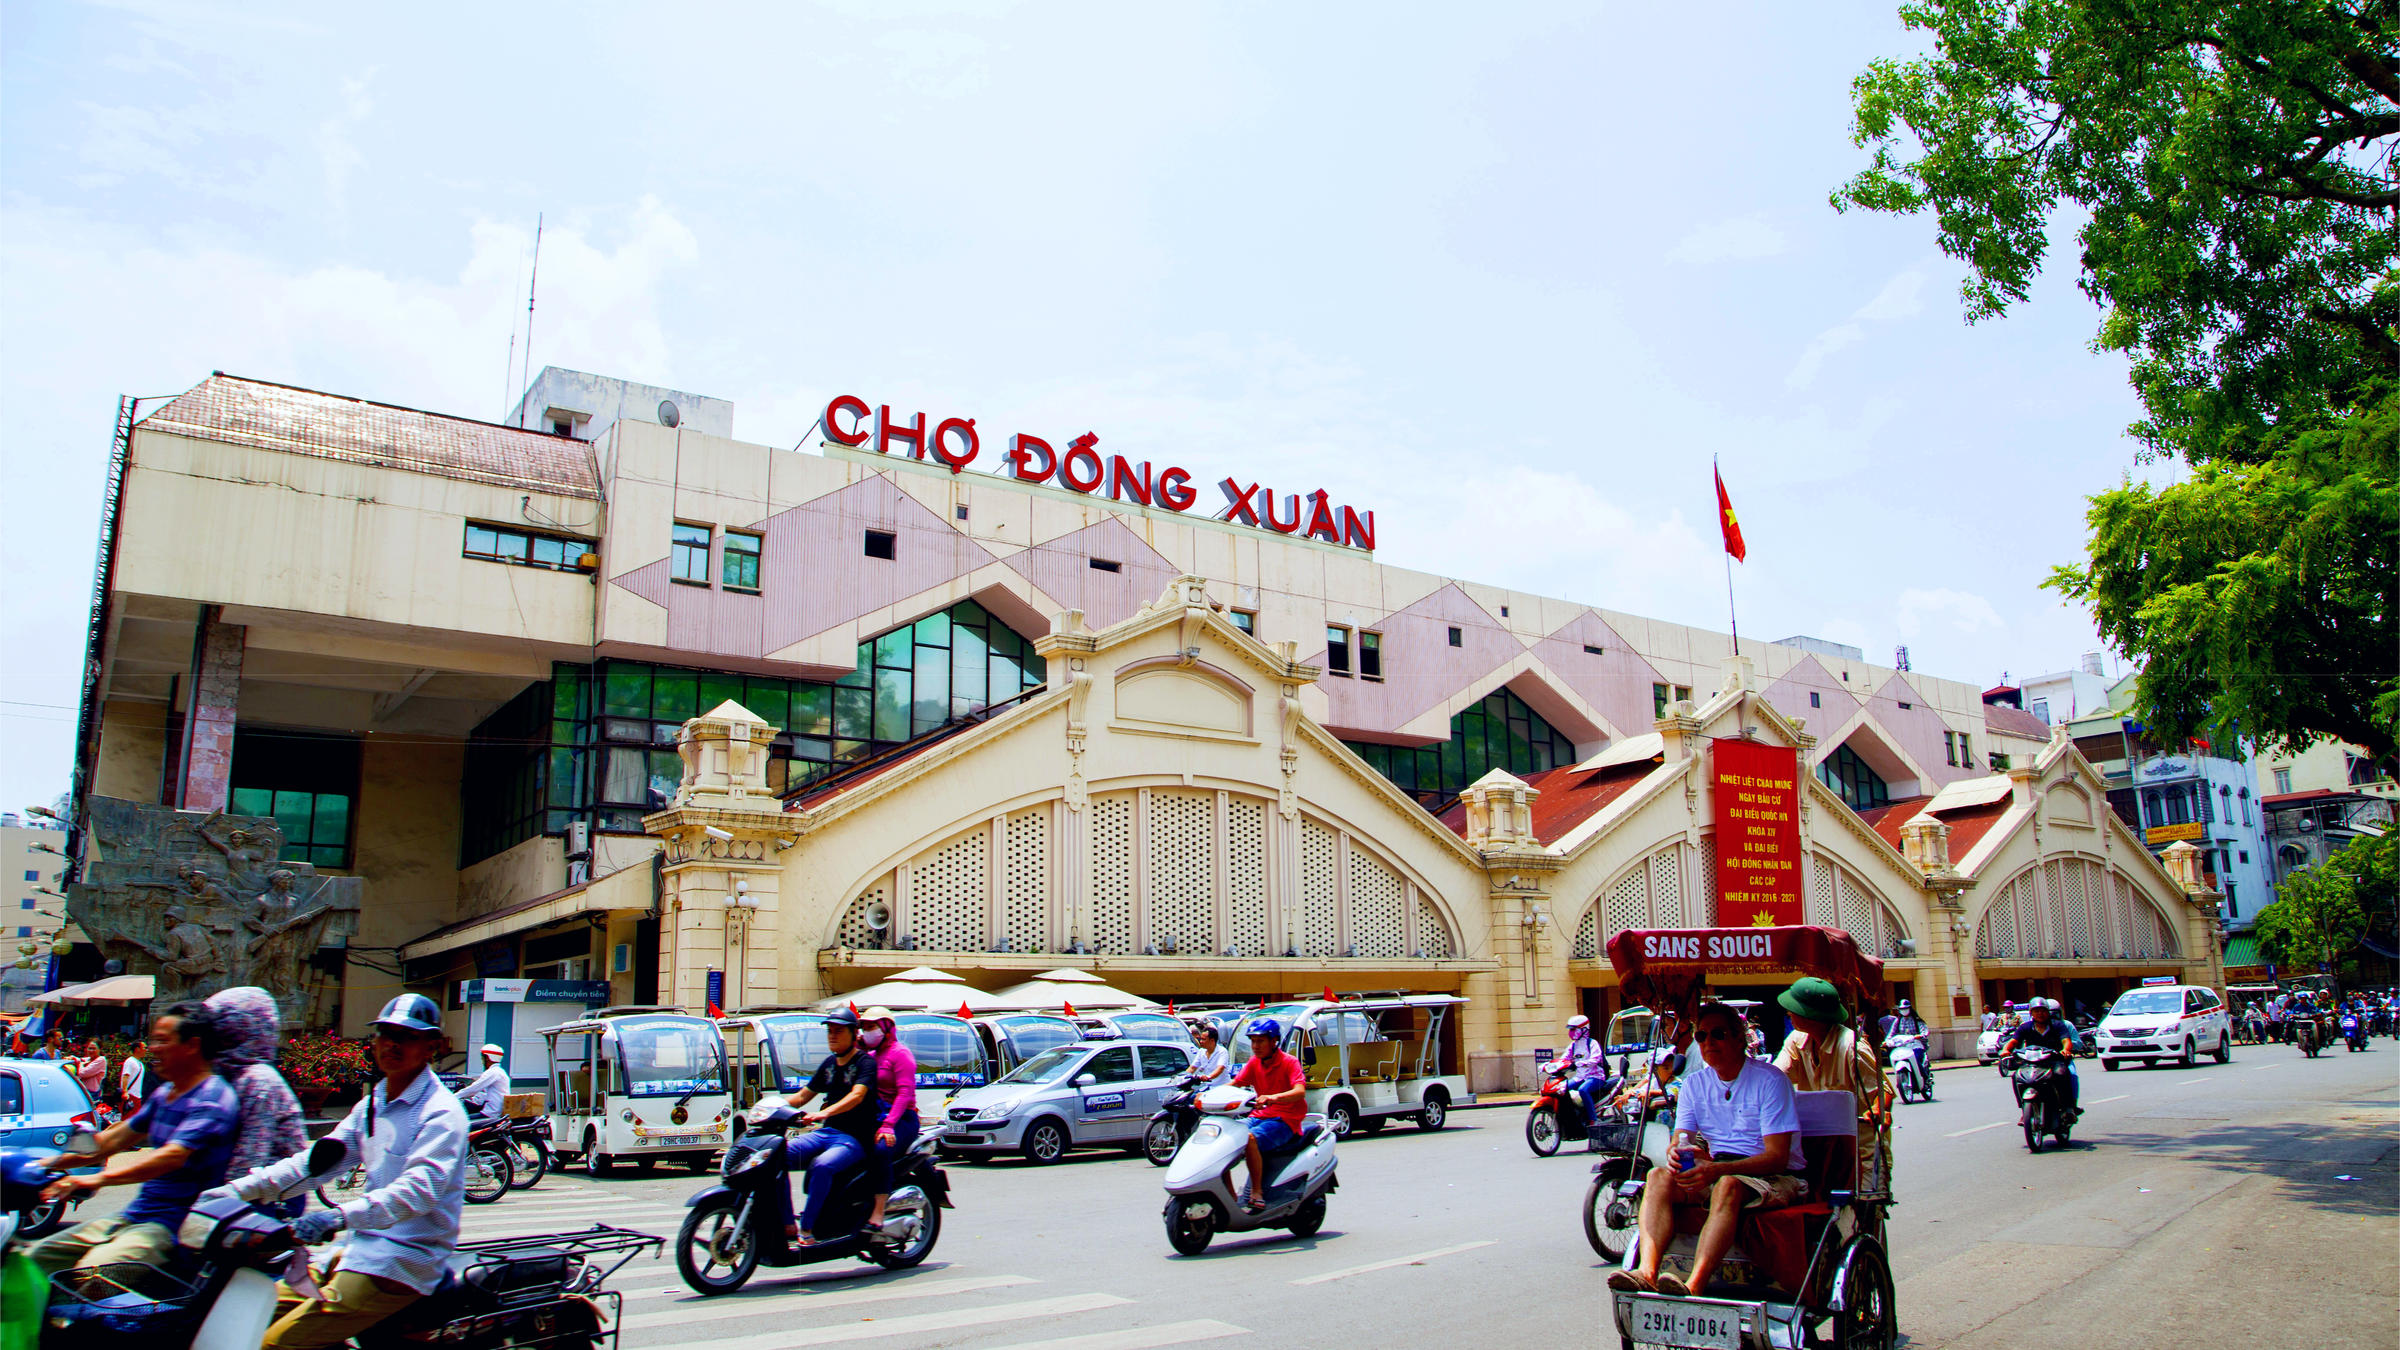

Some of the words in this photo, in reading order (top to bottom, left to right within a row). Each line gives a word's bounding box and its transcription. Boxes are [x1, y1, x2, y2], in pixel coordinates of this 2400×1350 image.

[820, 395, 980, 475] CHỢ
[1002, 430, 1197, 512] ĐỒNG
[1218, 477, 1376, 550] XUÂN
[1720, 773, 1741, 786] NHIỆT
[1742, 775, 1755, 788] LIỆT
[1738, 791, 1756, 803] NGÀY
[1730, 807, 1742, 820] ĐẠI
[1744, 806, 1760, 819] BIỂU
[1760, 809, 1778, 821] QUỐC
[1747, 825, 1766, 836] KHÓA
[1767, 828, 1776, 836] XIV
[1744, 841, 1753, 852] VÀ
[1727, 856, 1740, 870] HỘI
[1742, 857, 1762, 869] ĐỒNG
[1749, 874, 1764, 886] CÁC
[1725, 890, 1749, 903] NHIỆM
[1761, 892, 1778, 903] 2016
[1781, 893, 1795, 903] 2021
[1644, 936, 1700, 959] SANS
[1707, 934, 1772, 958] SOUCI
[535, 988, 557, 997] Điểm
[558, 988, 588, 999] chuyển
